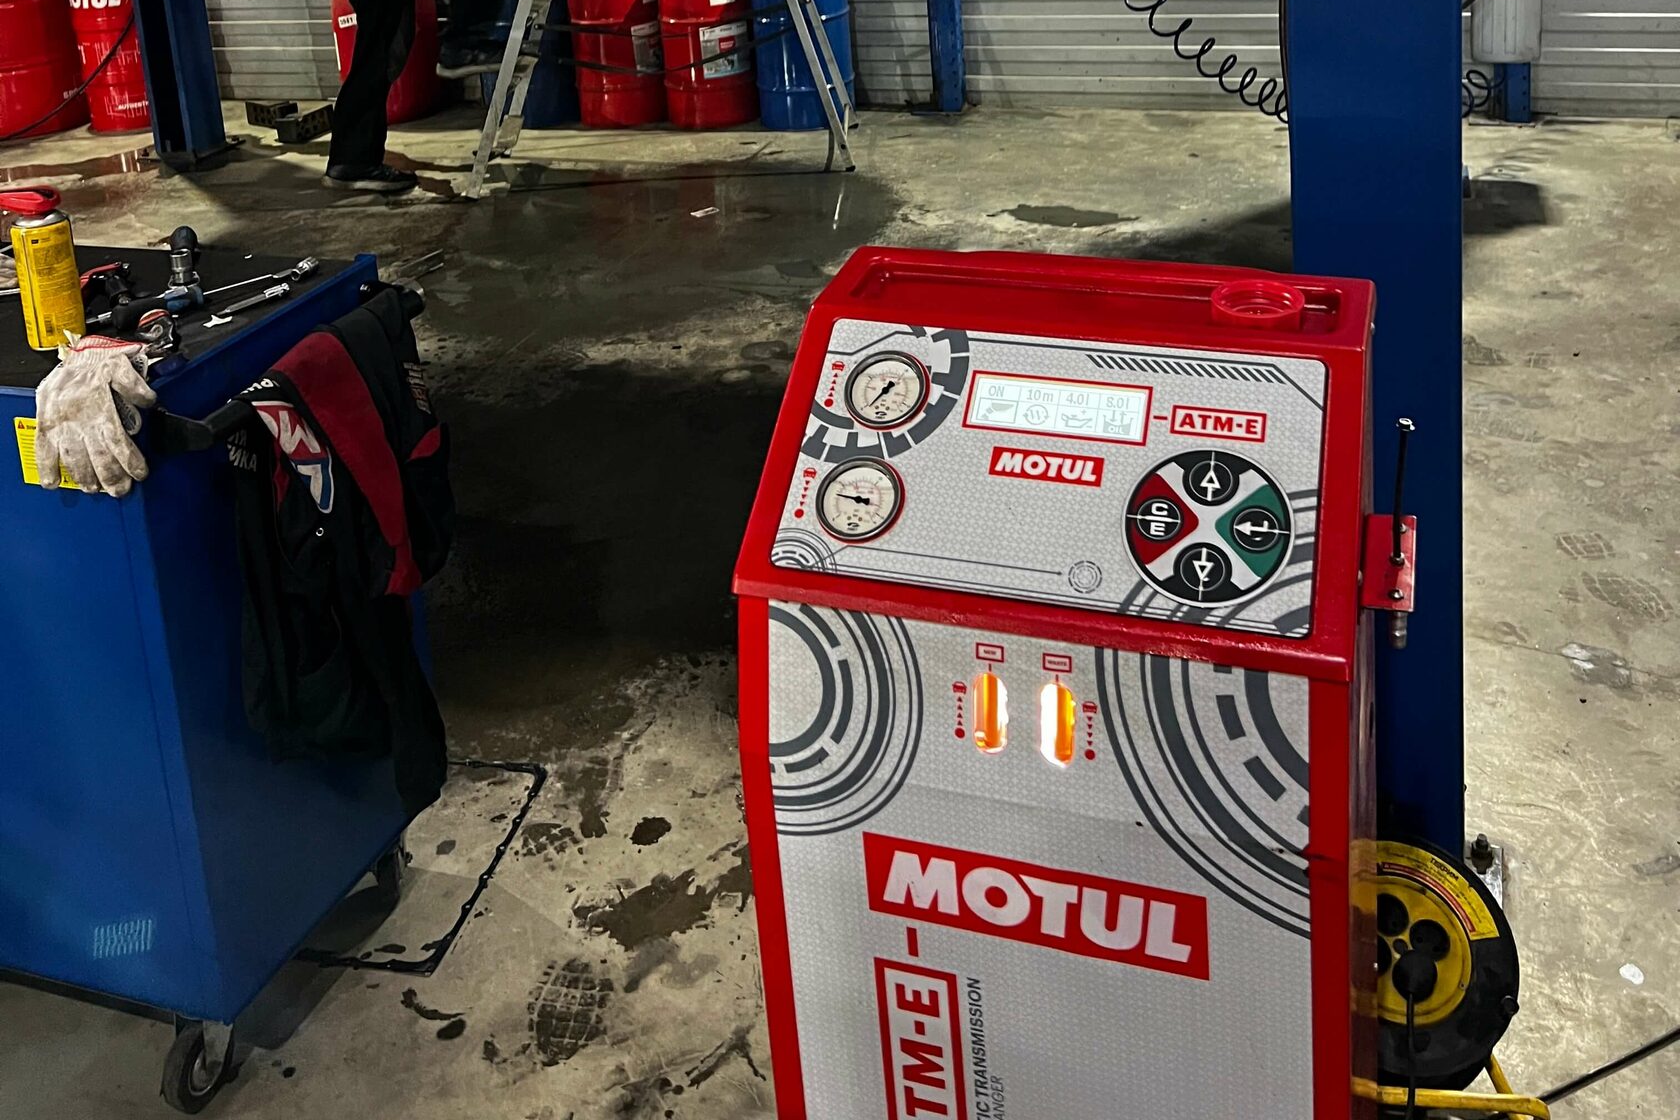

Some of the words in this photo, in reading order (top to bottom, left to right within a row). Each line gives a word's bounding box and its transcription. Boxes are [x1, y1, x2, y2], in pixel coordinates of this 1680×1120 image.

[988, 385, 1005, 398] ON
[1178, 412, 1259, 436] ATM-E
[994, 451, 1097, 483] MOTUL
[882, 849, 1192, 963] MOTUL
[894, 982, 948, 1118] TM-E
[966, 976, 990, 1098] TRANSMISSION
[976, 1101, 992, 1120] IC
